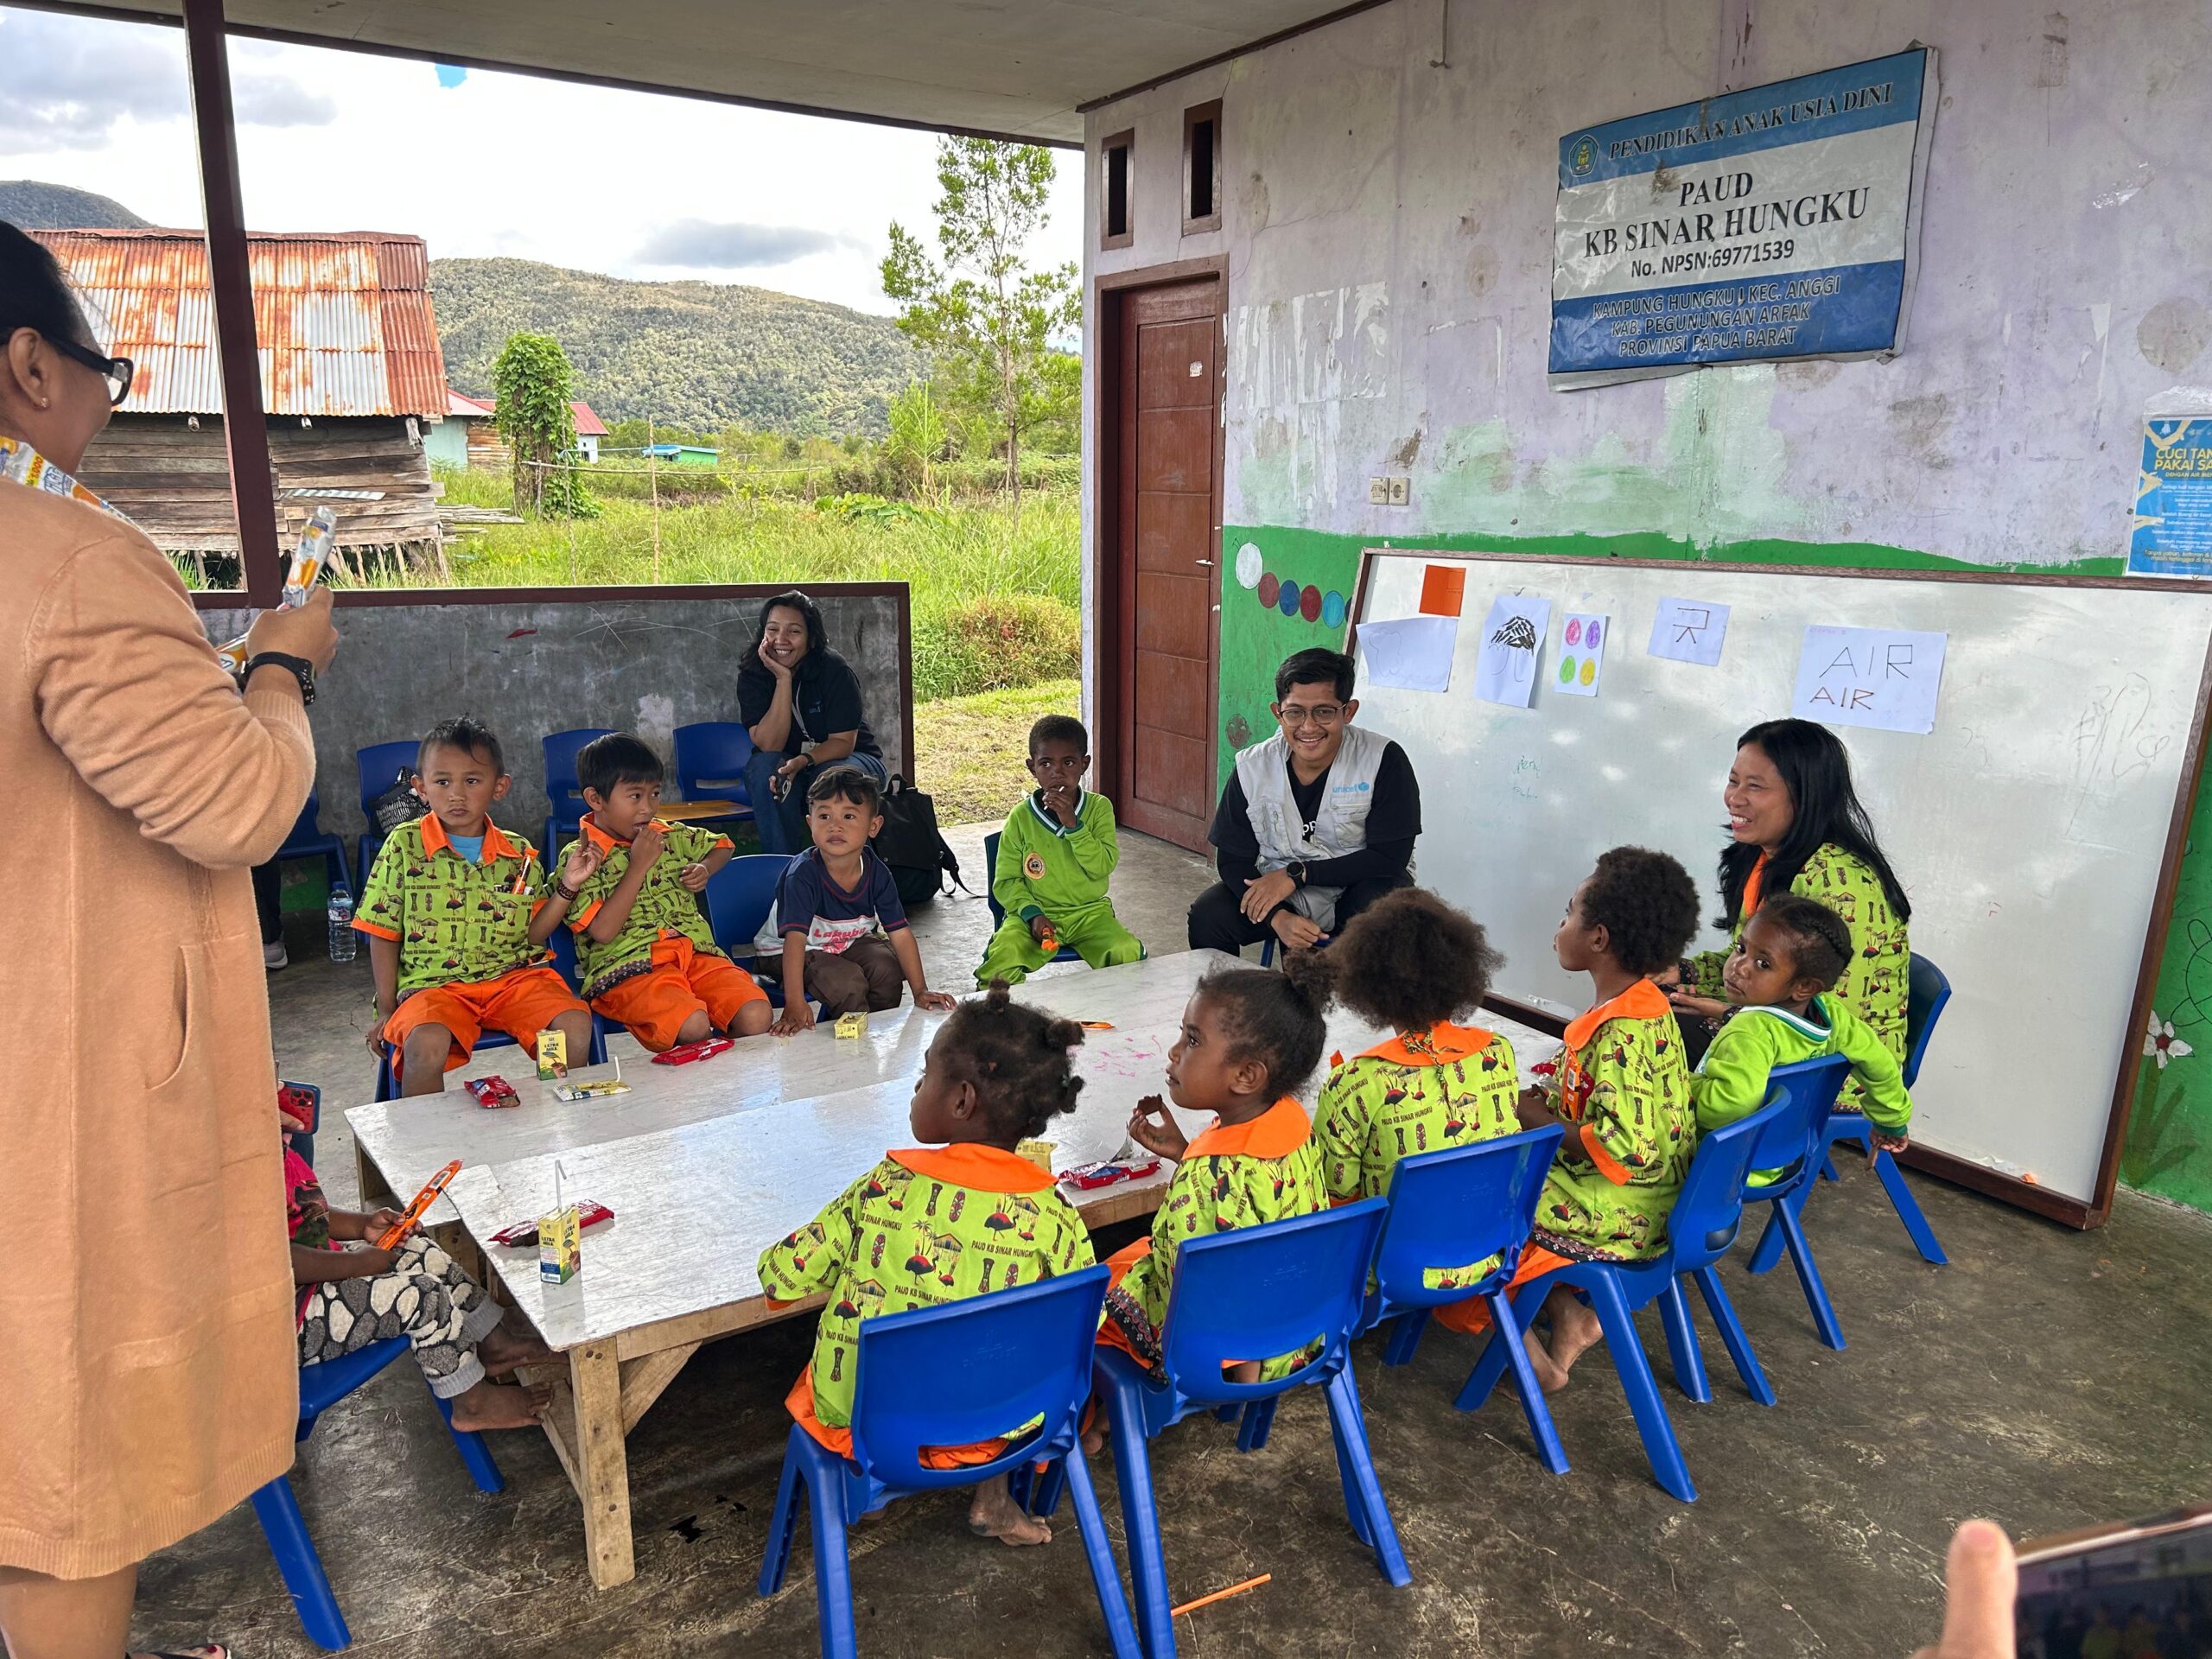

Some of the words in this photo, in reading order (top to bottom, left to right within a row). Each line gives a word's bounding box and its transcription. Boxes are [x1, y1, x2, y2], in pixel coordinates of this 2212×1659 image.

[1608, 119, 1727, 161] PENDIDIKAN
[1727, 106, 1785, 137] ANAK
[1789, 95, 1837, 124] USIA
[1841, 82, 1894, 111] DINI
[1678, 172, 1753, 207] PAUD
[1583, 227, 1618, 258] KB
[1624, 213, 1715, 252] SINAR
[1723, 187, 1871, 238] HUNGKU
[1630, 259, 1656, 277] No.
[1662, 238, 1795, 274] NPSN:69771539
[1592, 296, 1663, 319] KAMPUNG
[1668, 288, 1734, 311] HUNGKU
[1748, 283, 1782, 304] KEC.
[1785, 275, 1841, 299] ANGGI
[1611, 318, 1642, 337] KAB.
[1644, 308, 1755, 334] PEGUNUNGAN
[1758, 301, 1812, 323] ARFAK
[1618, 335, 1688, 357] PROVINSI
[1692, 331, 1741, 353] PAPUA
[1745, 326, 1797, 347] BARAT
[2154, 459, 2195, 470] PAKAI
[2156, 448, 2187, 459] CUCI
[1819, 644, 1913, 680] AIR
[1809, 686, 1874, 710] AIR
[1332, 784, 1357, 793] unicef
[865, 1213, 881, 1225] SINAR
[881, 1218, 903, 1231] HUNGKU
[971, 1240, 986, 1251] PAUD
[986, 1243, 995, 1252] KB
[995, 1244, 1013, 1255] SINAR
[894, 1284, 909, 1295] PAUD
[910, 1287, 918, 1296] KB
[918, 1289, 933, 1301] SINAR
